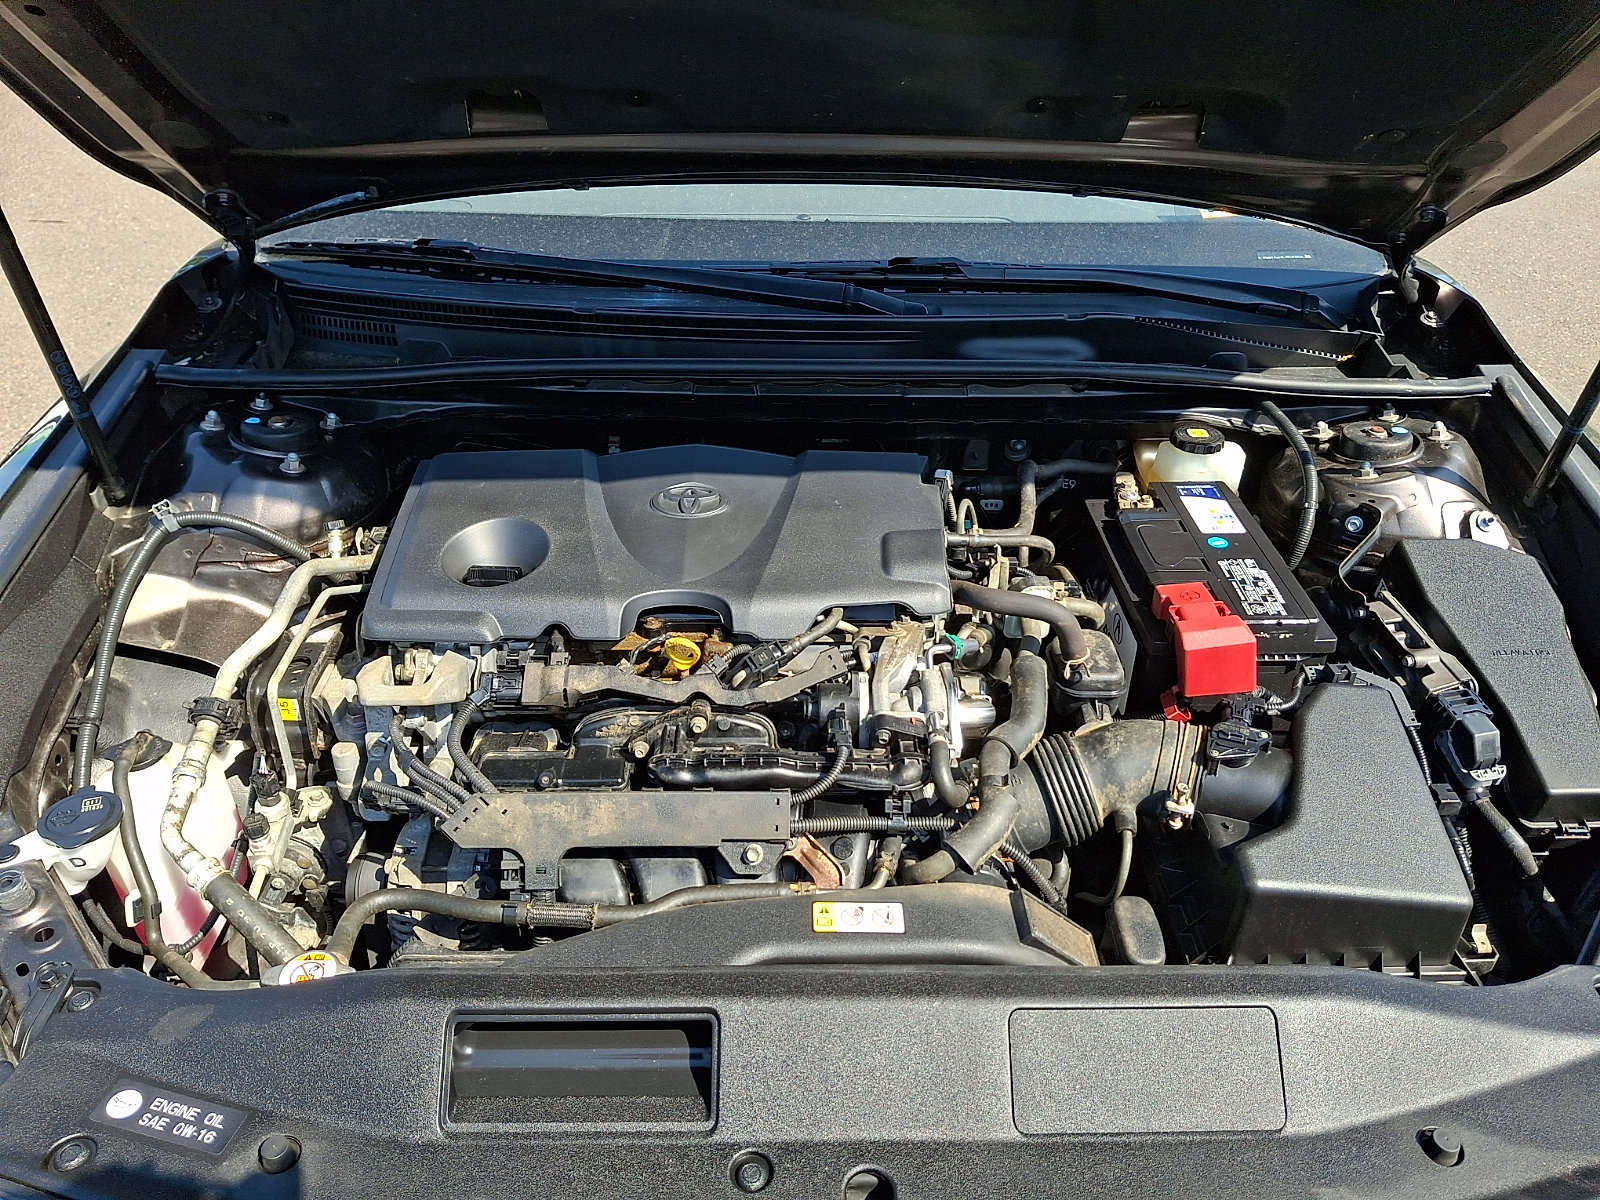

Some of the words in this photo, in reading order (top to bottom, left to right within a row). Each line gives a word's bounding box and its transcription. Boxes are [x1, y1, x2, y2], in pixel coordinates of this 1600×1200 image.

[1062, 478, 1077, 490] E9
[280, 701, 290, 714] J5
[149, 1097, 202, 1121] ENGINE
[203, 1112, 225, 1130] OIL
[138, 1113, 171, 1132] SAE
[172, 1122, 218, 1144] 0W-16
